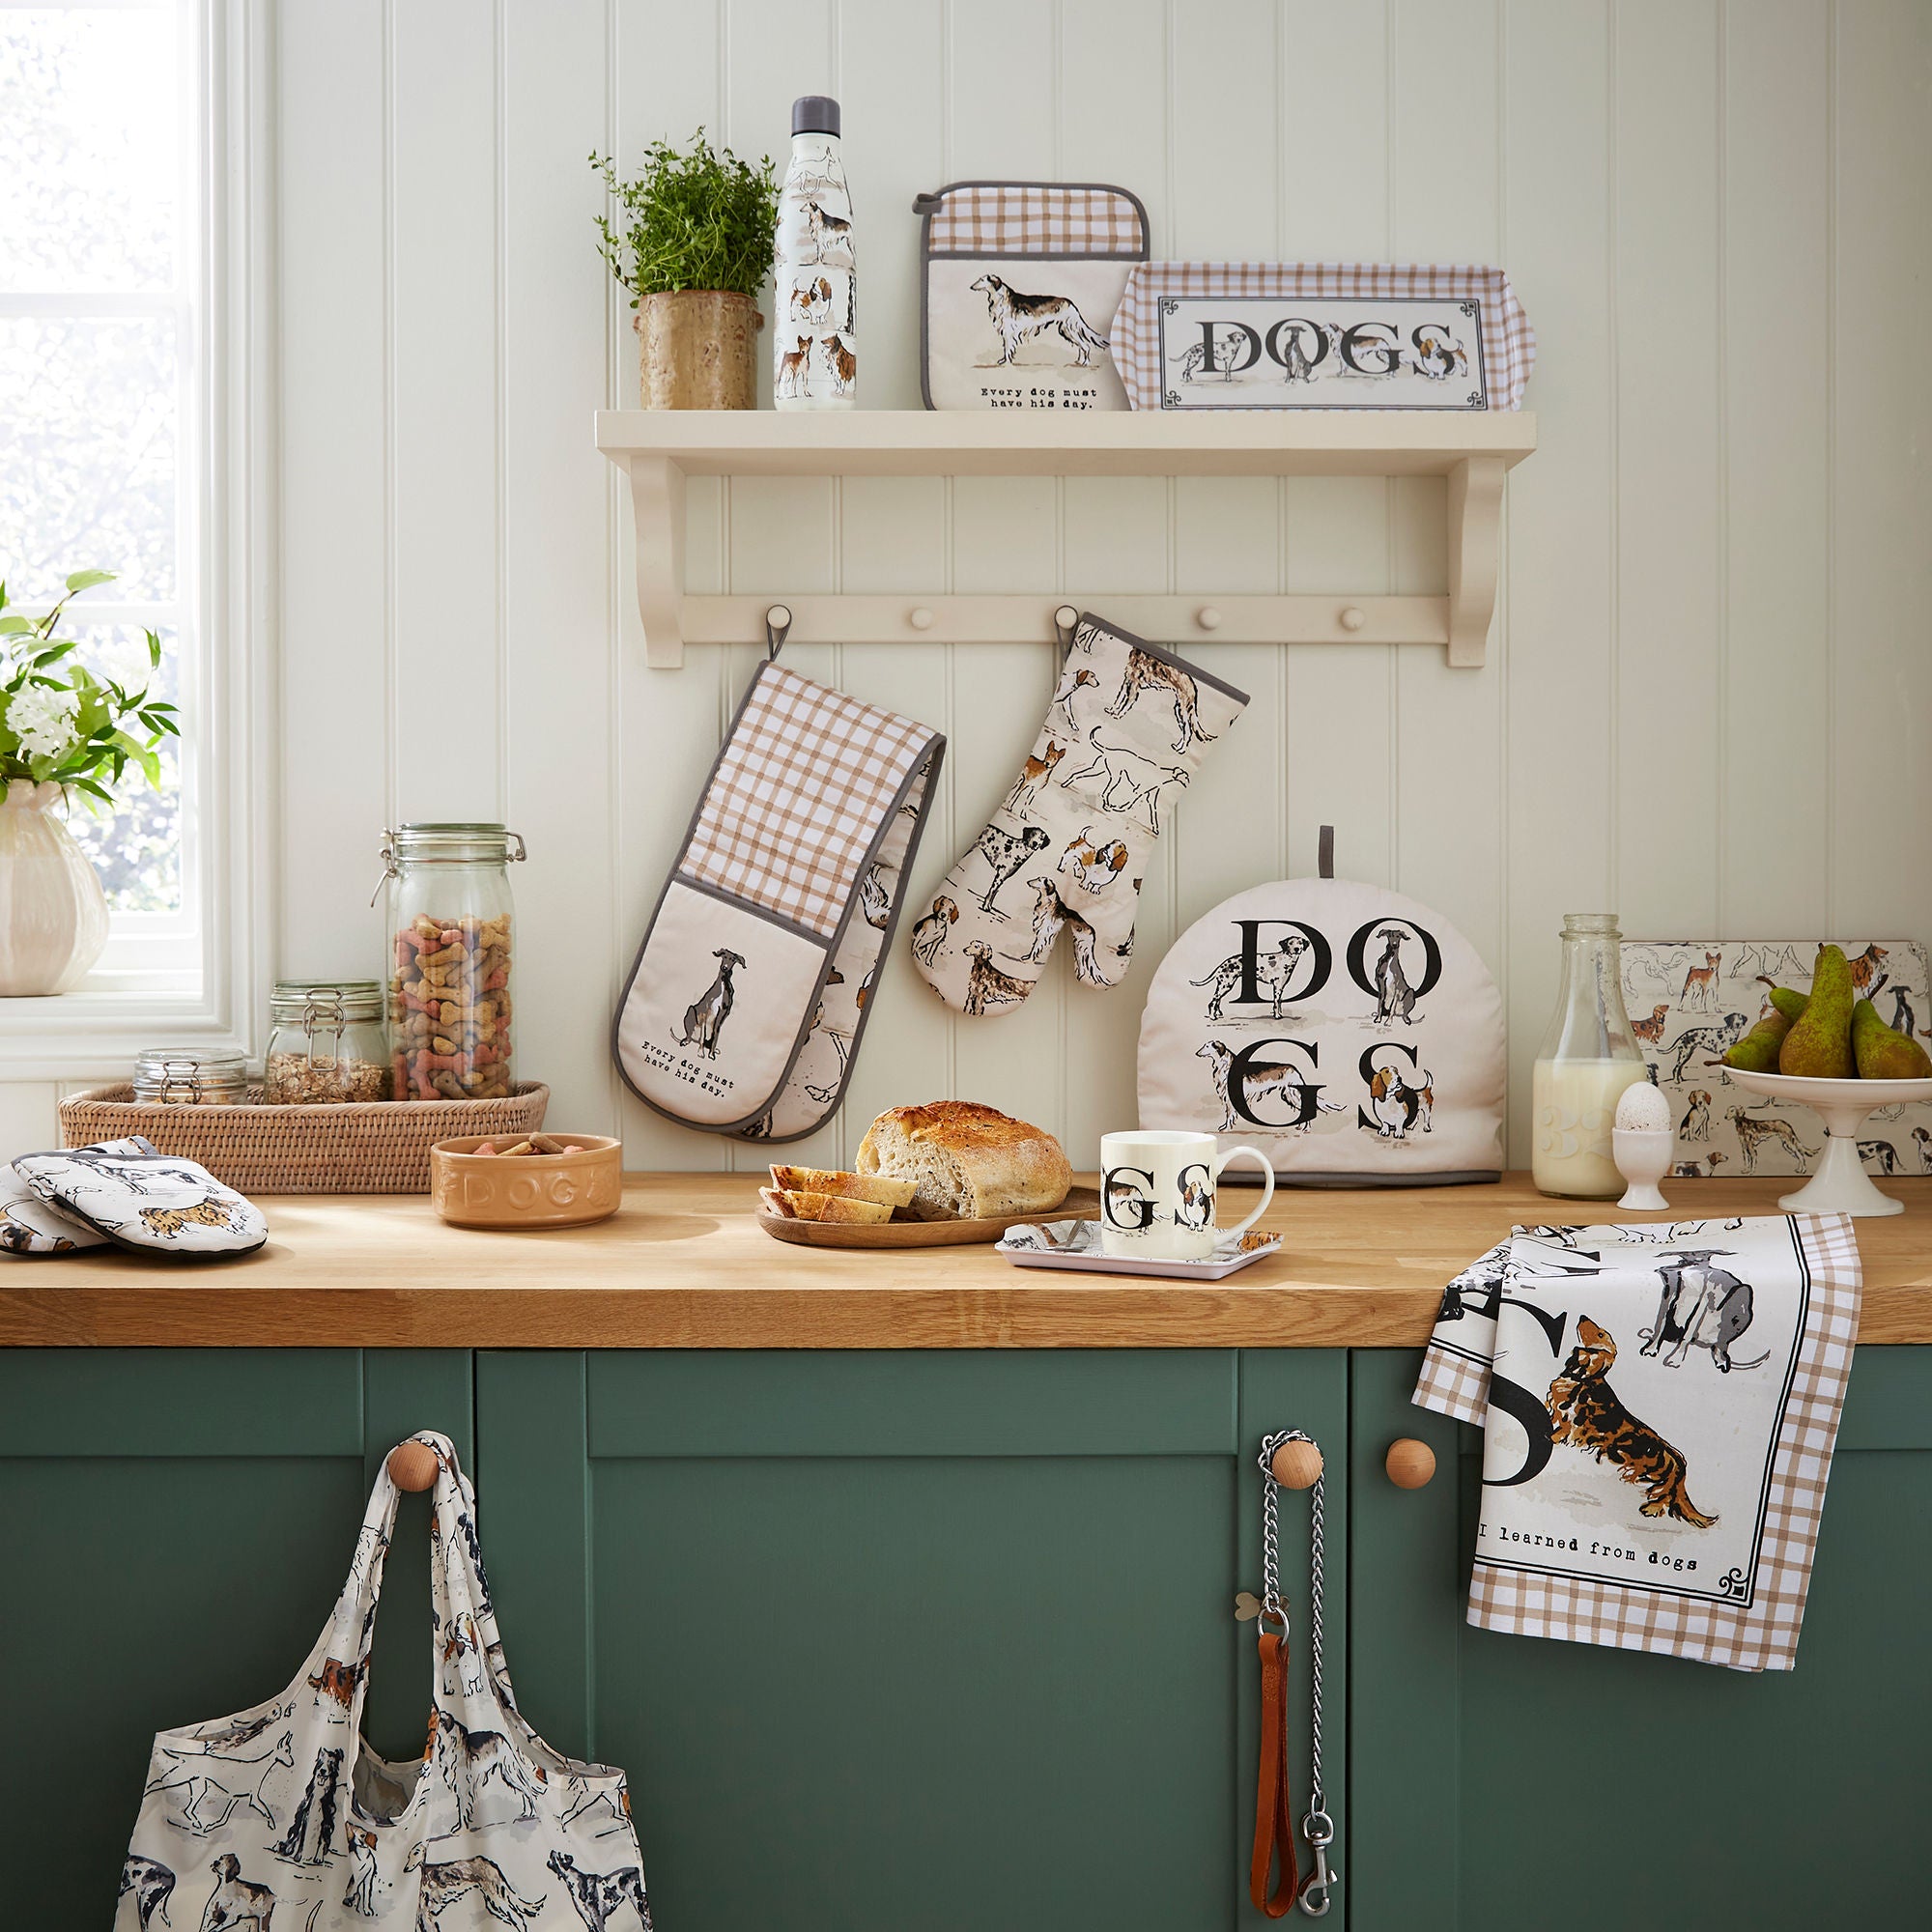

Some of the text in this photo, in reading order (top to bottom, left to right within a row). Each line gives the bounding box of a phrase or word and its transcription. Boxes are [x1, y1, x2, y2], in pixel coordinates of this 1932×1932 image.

[1195, 317, 1455, 376] DOGS
[980, 387, 1097, 398] Every dog must
[990, 399, 1093, 411] have his day.
[1229, 918, 1442, 1005] DO
[641, 1040, 734, 1089] Every dog must
[643, 1054, 725, 1098] have his day.
[464, 1172, 578, 1210] DOG
[1478, 1522, 1698, 1572] I learned from dogs
